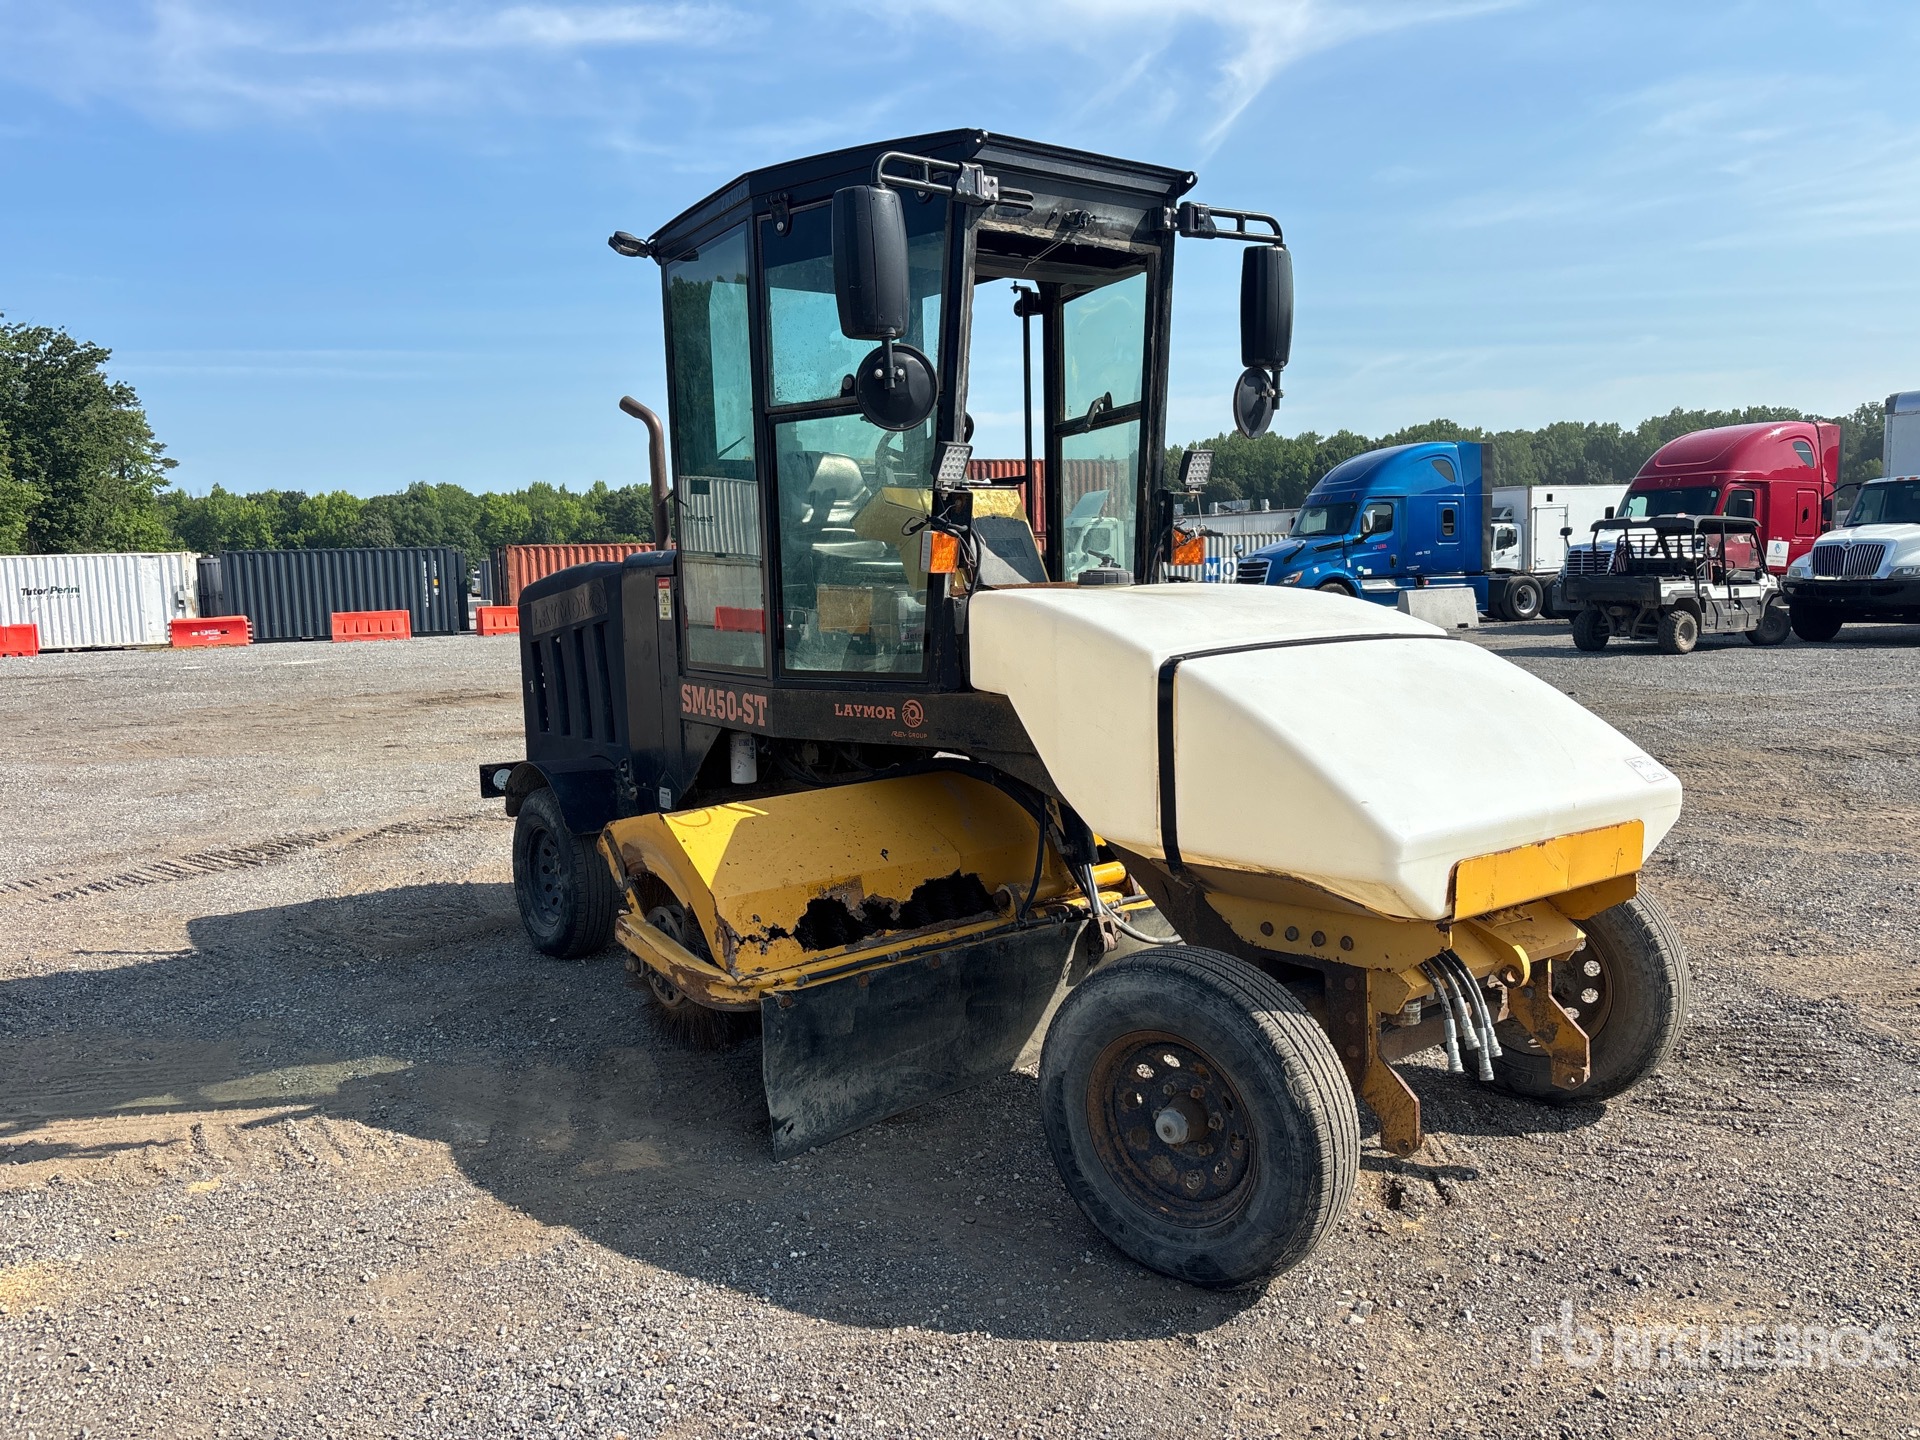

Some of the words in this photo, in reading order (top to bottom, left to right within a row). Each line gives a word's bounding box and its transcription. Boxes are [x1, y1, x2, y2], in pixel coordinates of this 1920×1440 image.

[21, 587, 48, 597] Tutor
[50, 584, 80, 594] Perini
[534, 592, 588, 628] LAYMOR
[681, 683, 768, 727] SM450-ST
[834, 703, 896, 720] LAYMOR
[891, 730, 907, 738] REV
[908, 731, 928, 739] GROUP
